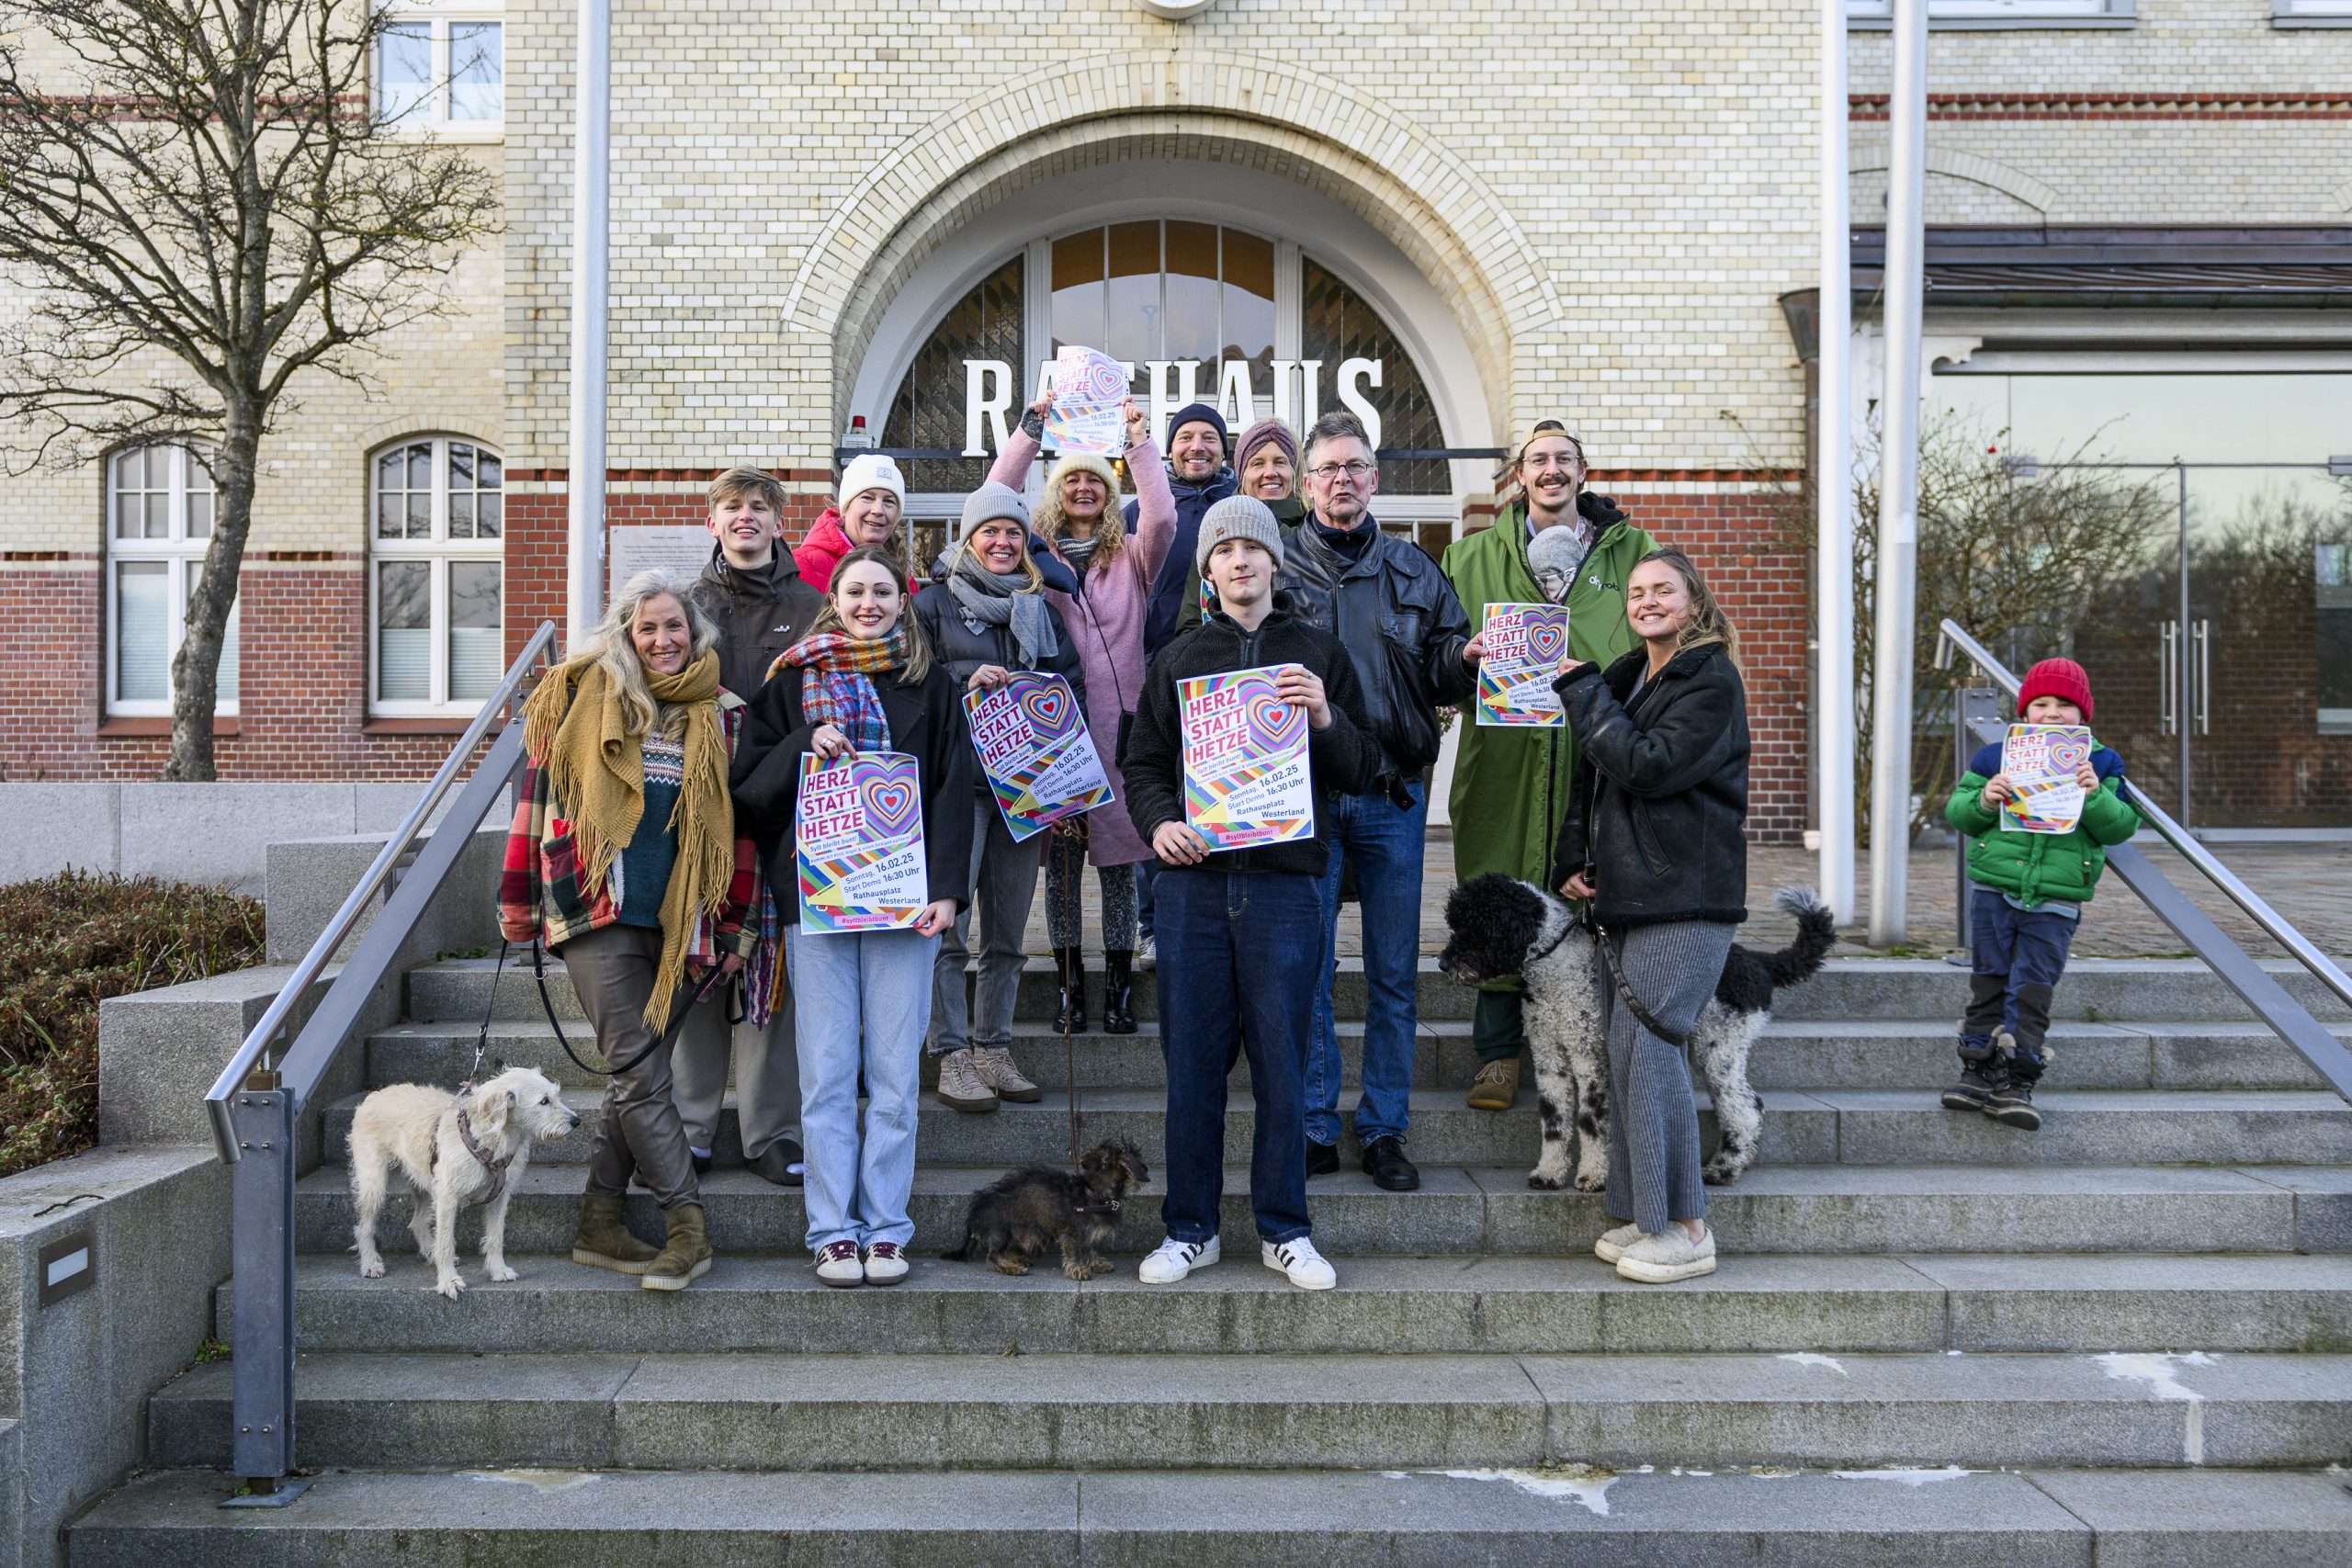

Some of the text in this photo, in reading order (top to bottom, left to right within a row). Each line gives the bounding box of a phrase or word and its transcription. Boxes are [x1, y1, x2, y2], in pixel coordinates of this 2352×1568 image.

[961, 357, 1383, 457] RHAUS
[1488, 614, 1521, 630] HERZ
[1488, 629, 1525, 646] STATT
[1487, 645, 1526, 660] HETZE
[973, 690, 1010, 727] HERZ
[1190, 687, 1237, 717] HERZ
[979, 705, 1021, 745] STATT
[1192, 707, 1244, 739] STATT
[987, 724, 1032, 764] HETZE
[1193, 729, 1248, 763] HETZE
[2009, 748, 2046, 761] STATT
[2010, 735, 2043, 749] HERZ
[1054, 744, 1085, 772] 16.02.25
[806, 768, 850, 793] HERZ
[1034, 754, 1093, 796] Start Demo 16:30 Uhr
[1066, 779, 1102, 796] Westerland
[1260, 764, 1298, 787] 16.02.25
[1043, 777, 1083, 800] Rathausplatz
[1227, 777, 1305, 810] Start Demo 16:30 Uhr
[805, 788, 857, 817] STATT
[1237, 799, 1285, 816] Rathausplatz
[1261, 808, 1305, 818] Westerland
[805, 810, 864, 840] HETZE
[876, 852, 914, 873] 16.02.25
[843, 867, 920, 894] Start Demo 16:30 Uhr
[854, 886, 901, 900] Rathausplatz
[878, 897, 921, 905] Westerland
